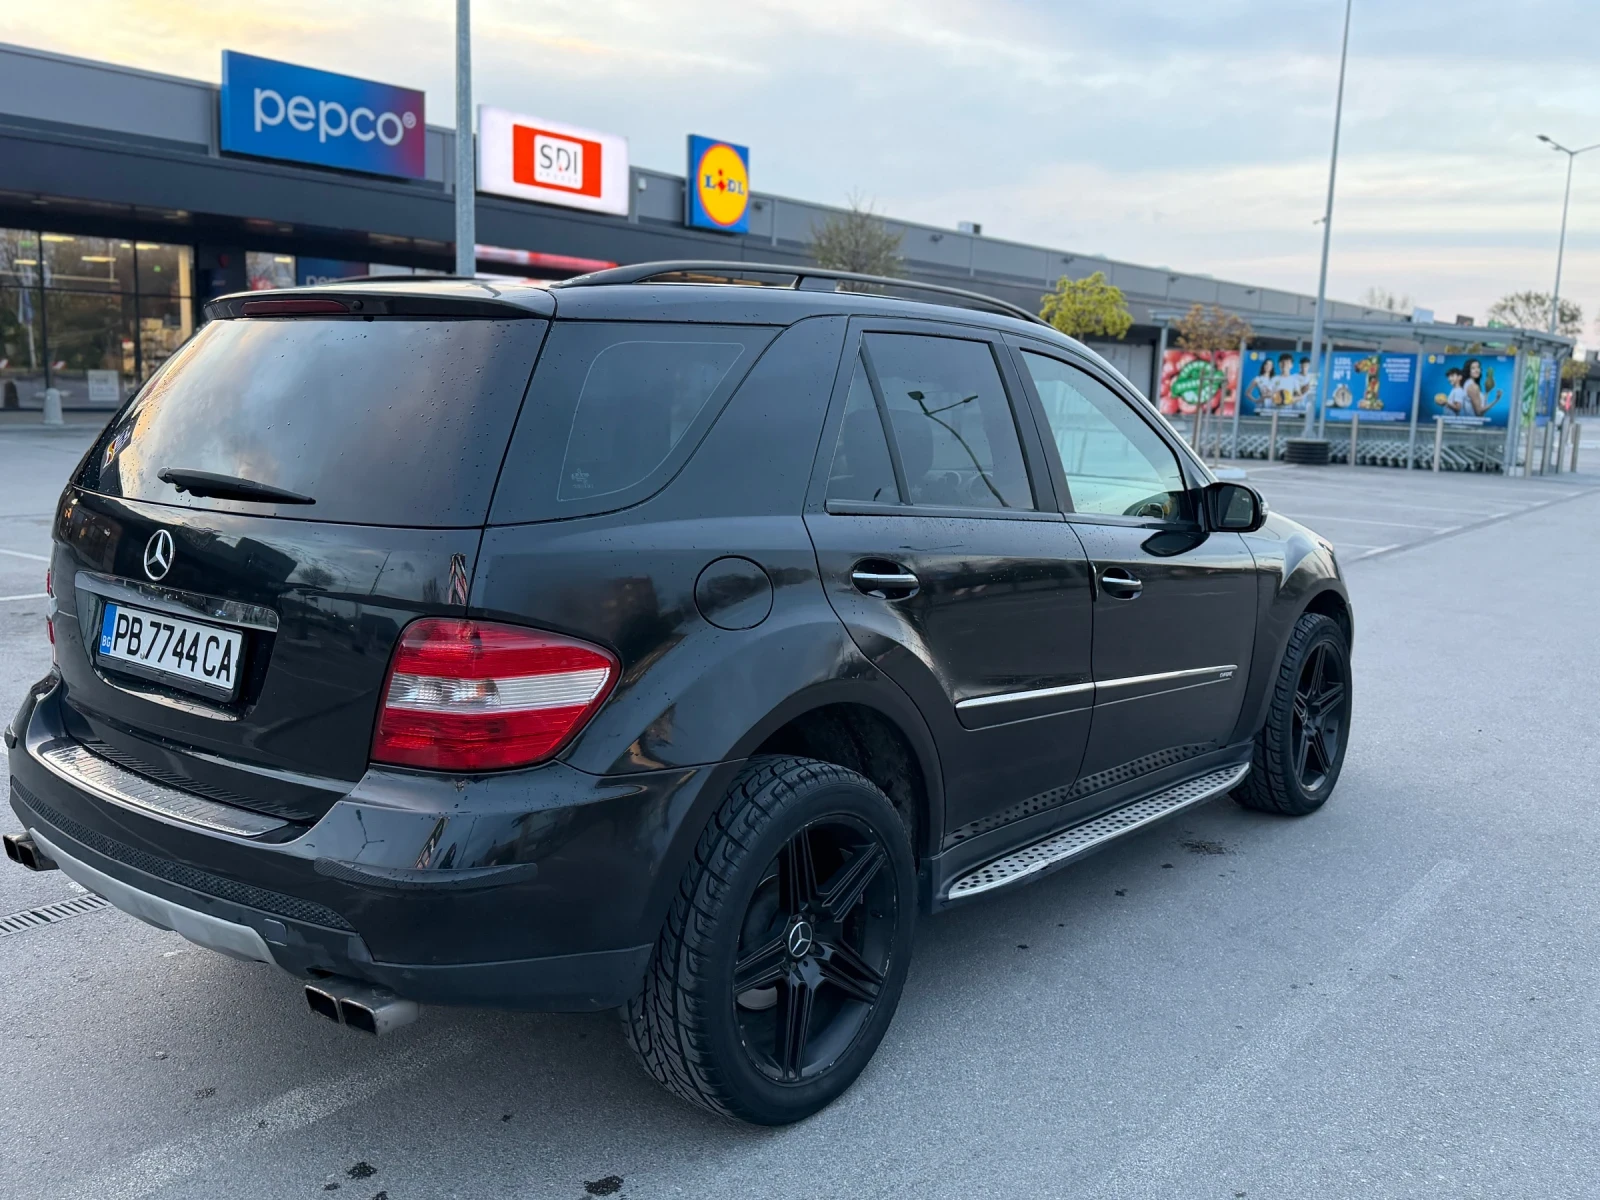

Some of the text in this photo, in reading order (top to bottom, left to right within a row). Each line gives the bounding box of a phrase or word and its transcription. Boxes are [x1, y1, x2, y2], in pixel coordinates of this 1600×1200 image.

[540, 144, 577, 175] SDI
[704, 169, 745, 196] LIDL
[101, 635, 111, 647] BG
